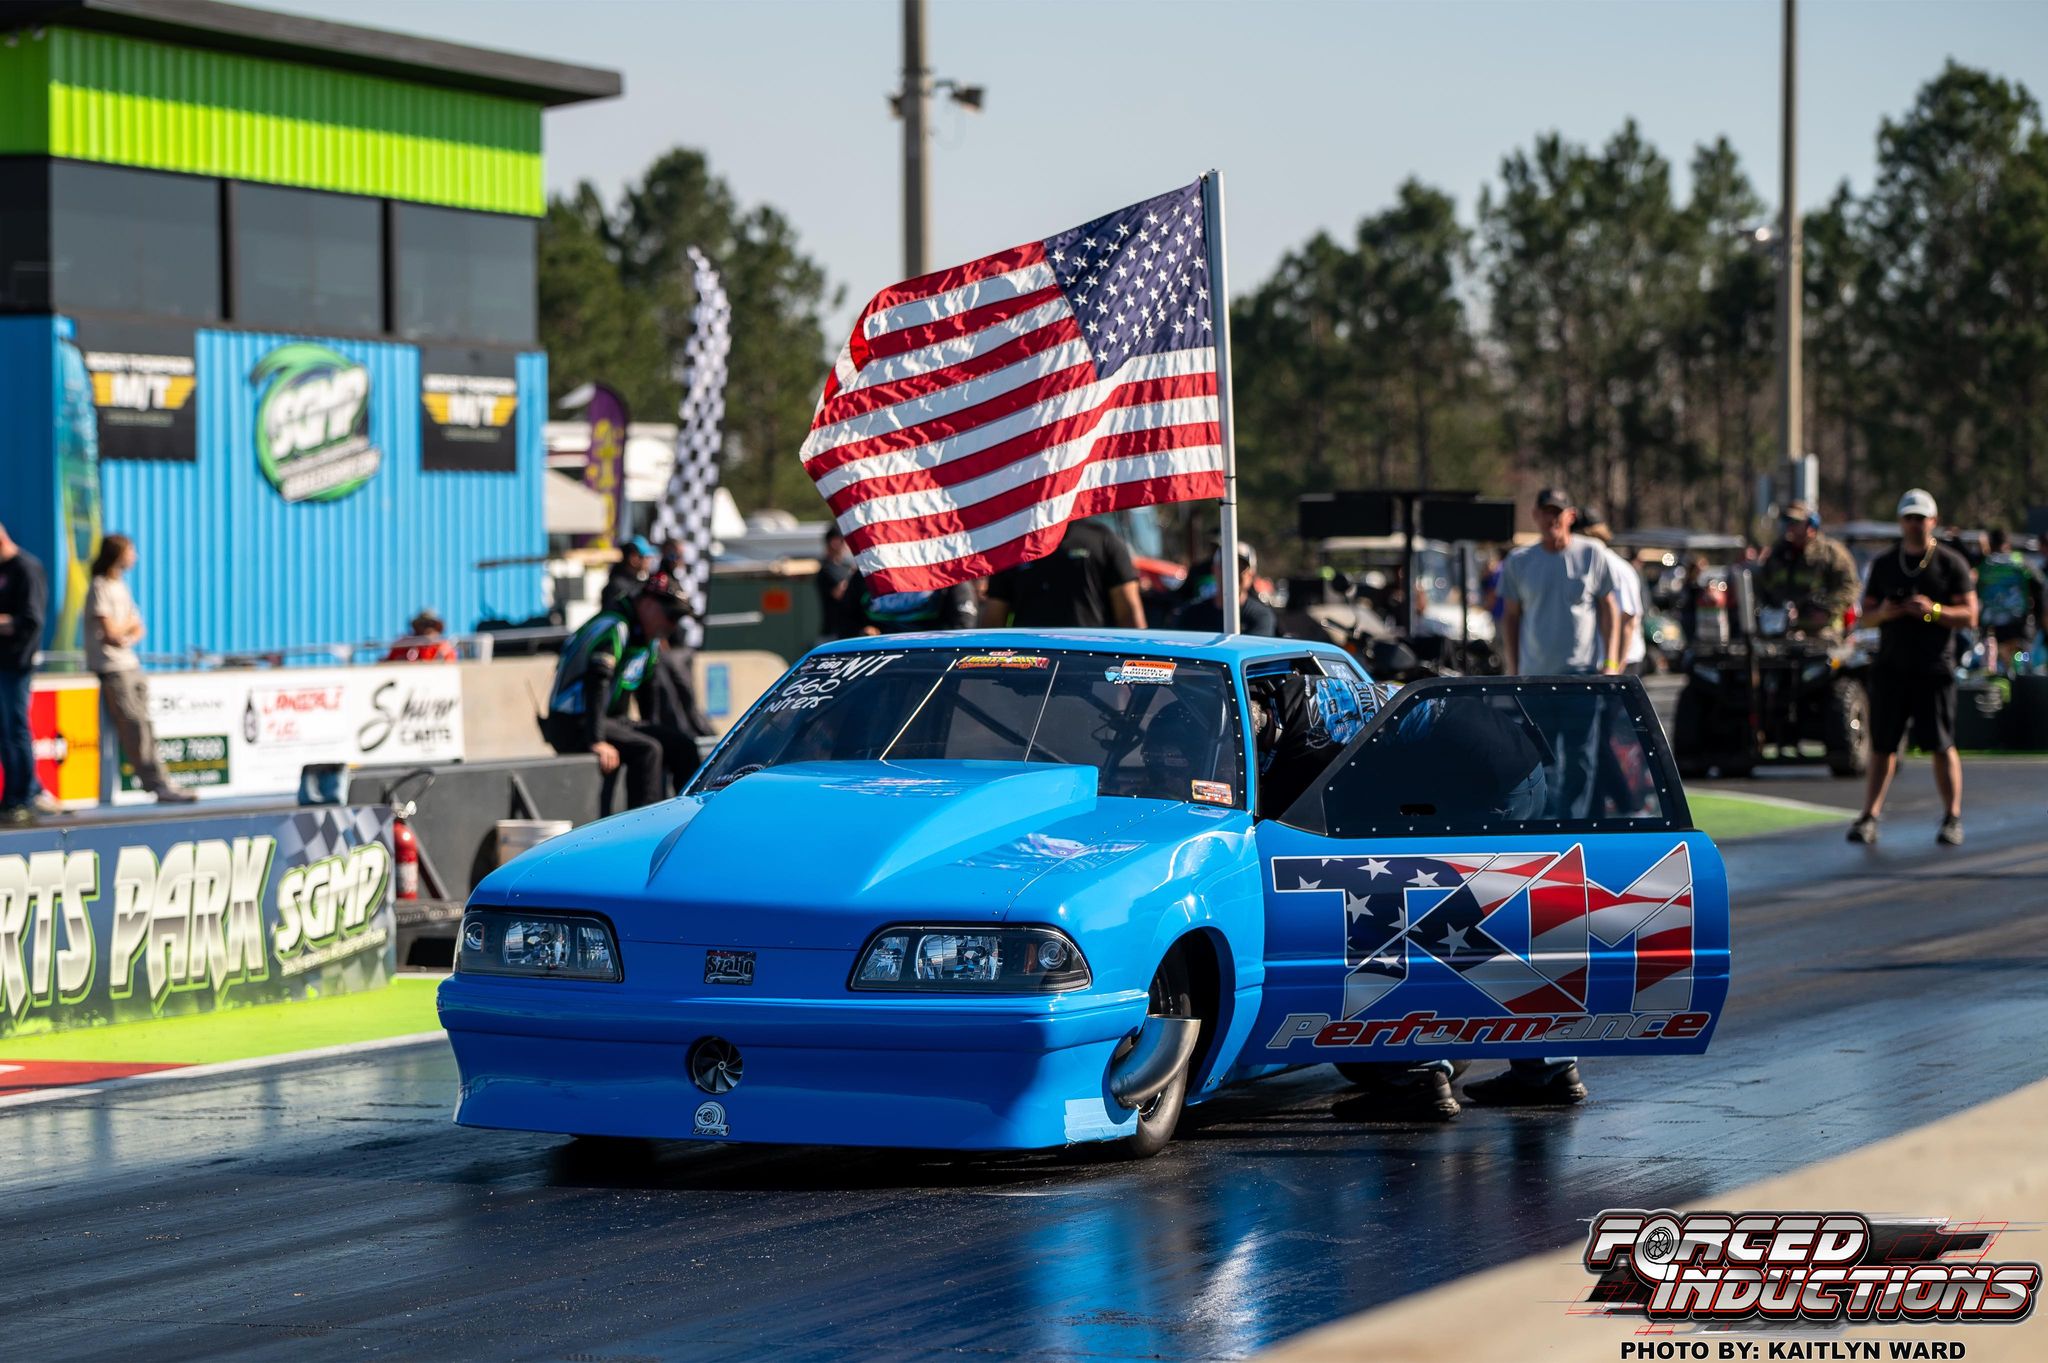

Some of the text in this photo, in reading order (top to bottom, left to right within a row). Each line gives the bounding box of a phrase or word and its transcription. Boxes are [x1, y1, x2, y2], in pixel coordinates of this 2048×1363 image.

[782, 677, 840, 697] 660
[110, 836, 276, 1004] PARK
[274, 843, 390, 956] SGMP
[1266, 1011, 1710, 1048] Performance
